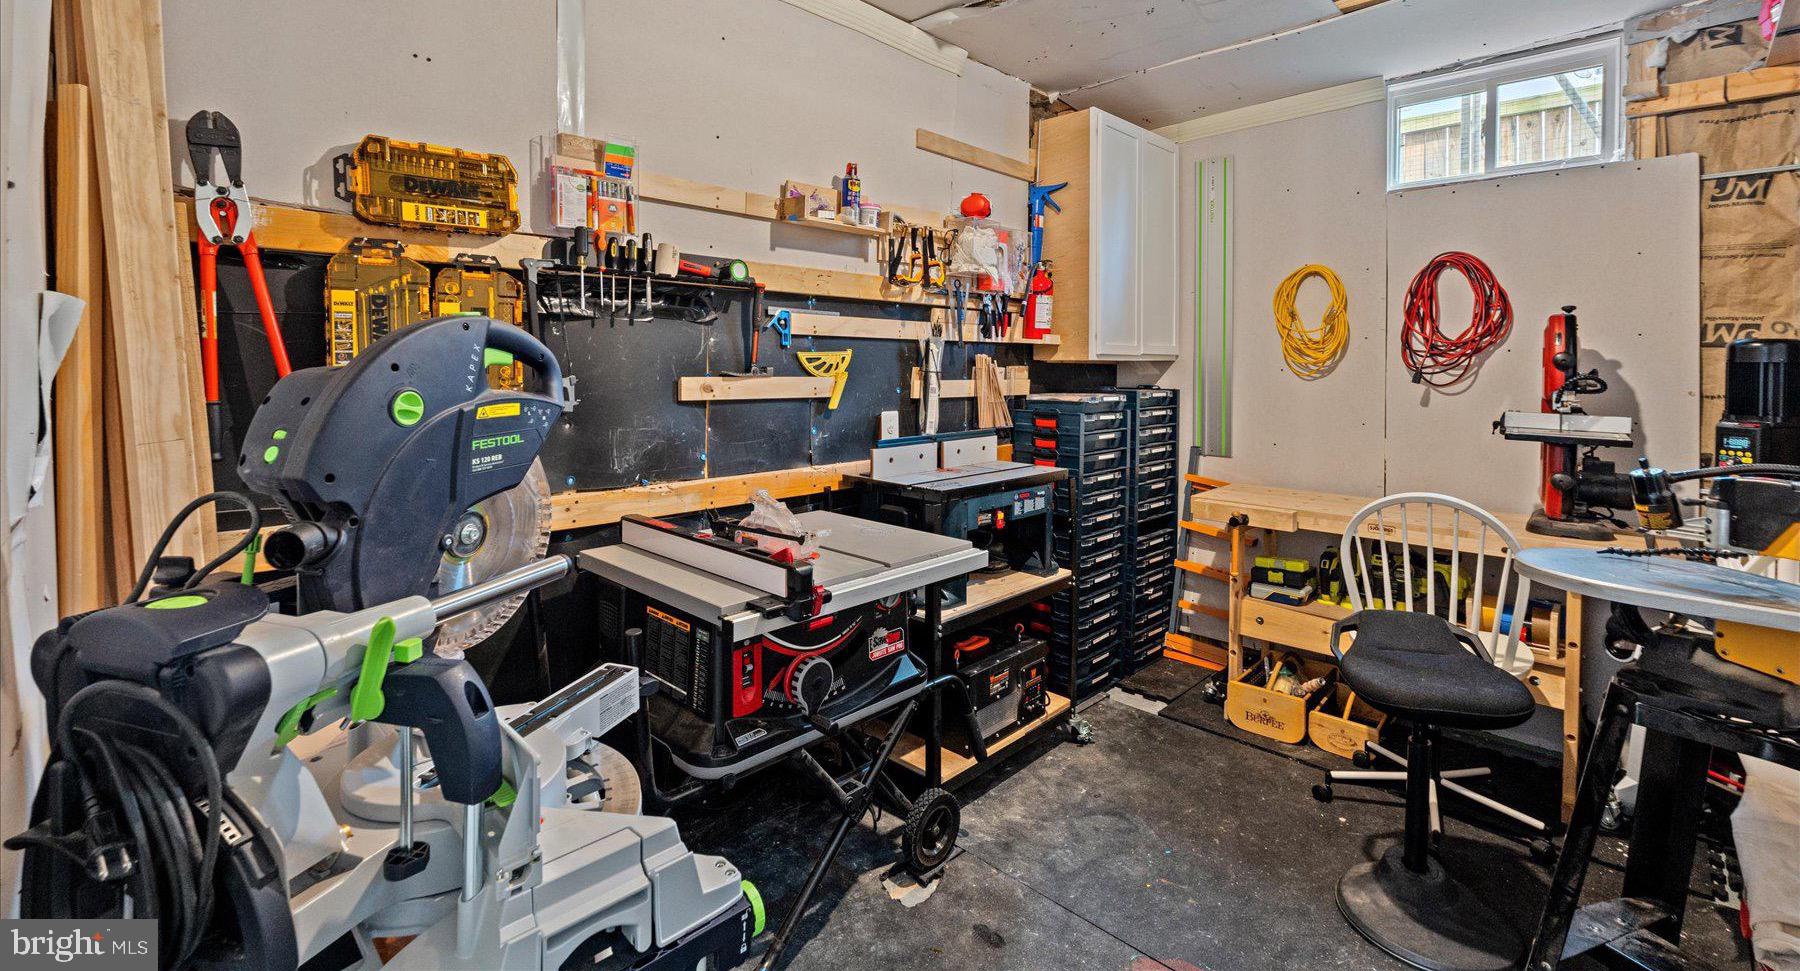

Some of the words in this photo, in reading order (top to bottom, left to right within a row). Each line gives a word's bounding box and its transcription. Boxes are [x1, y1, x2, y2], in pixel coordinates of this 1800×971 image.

[465, 344, 481, 392] KAPEX
[471, 434, 525, 451] FESTOOL
[481, 455, 491, 463] 120
[1245, 710, 1285, 731] BURPEE
